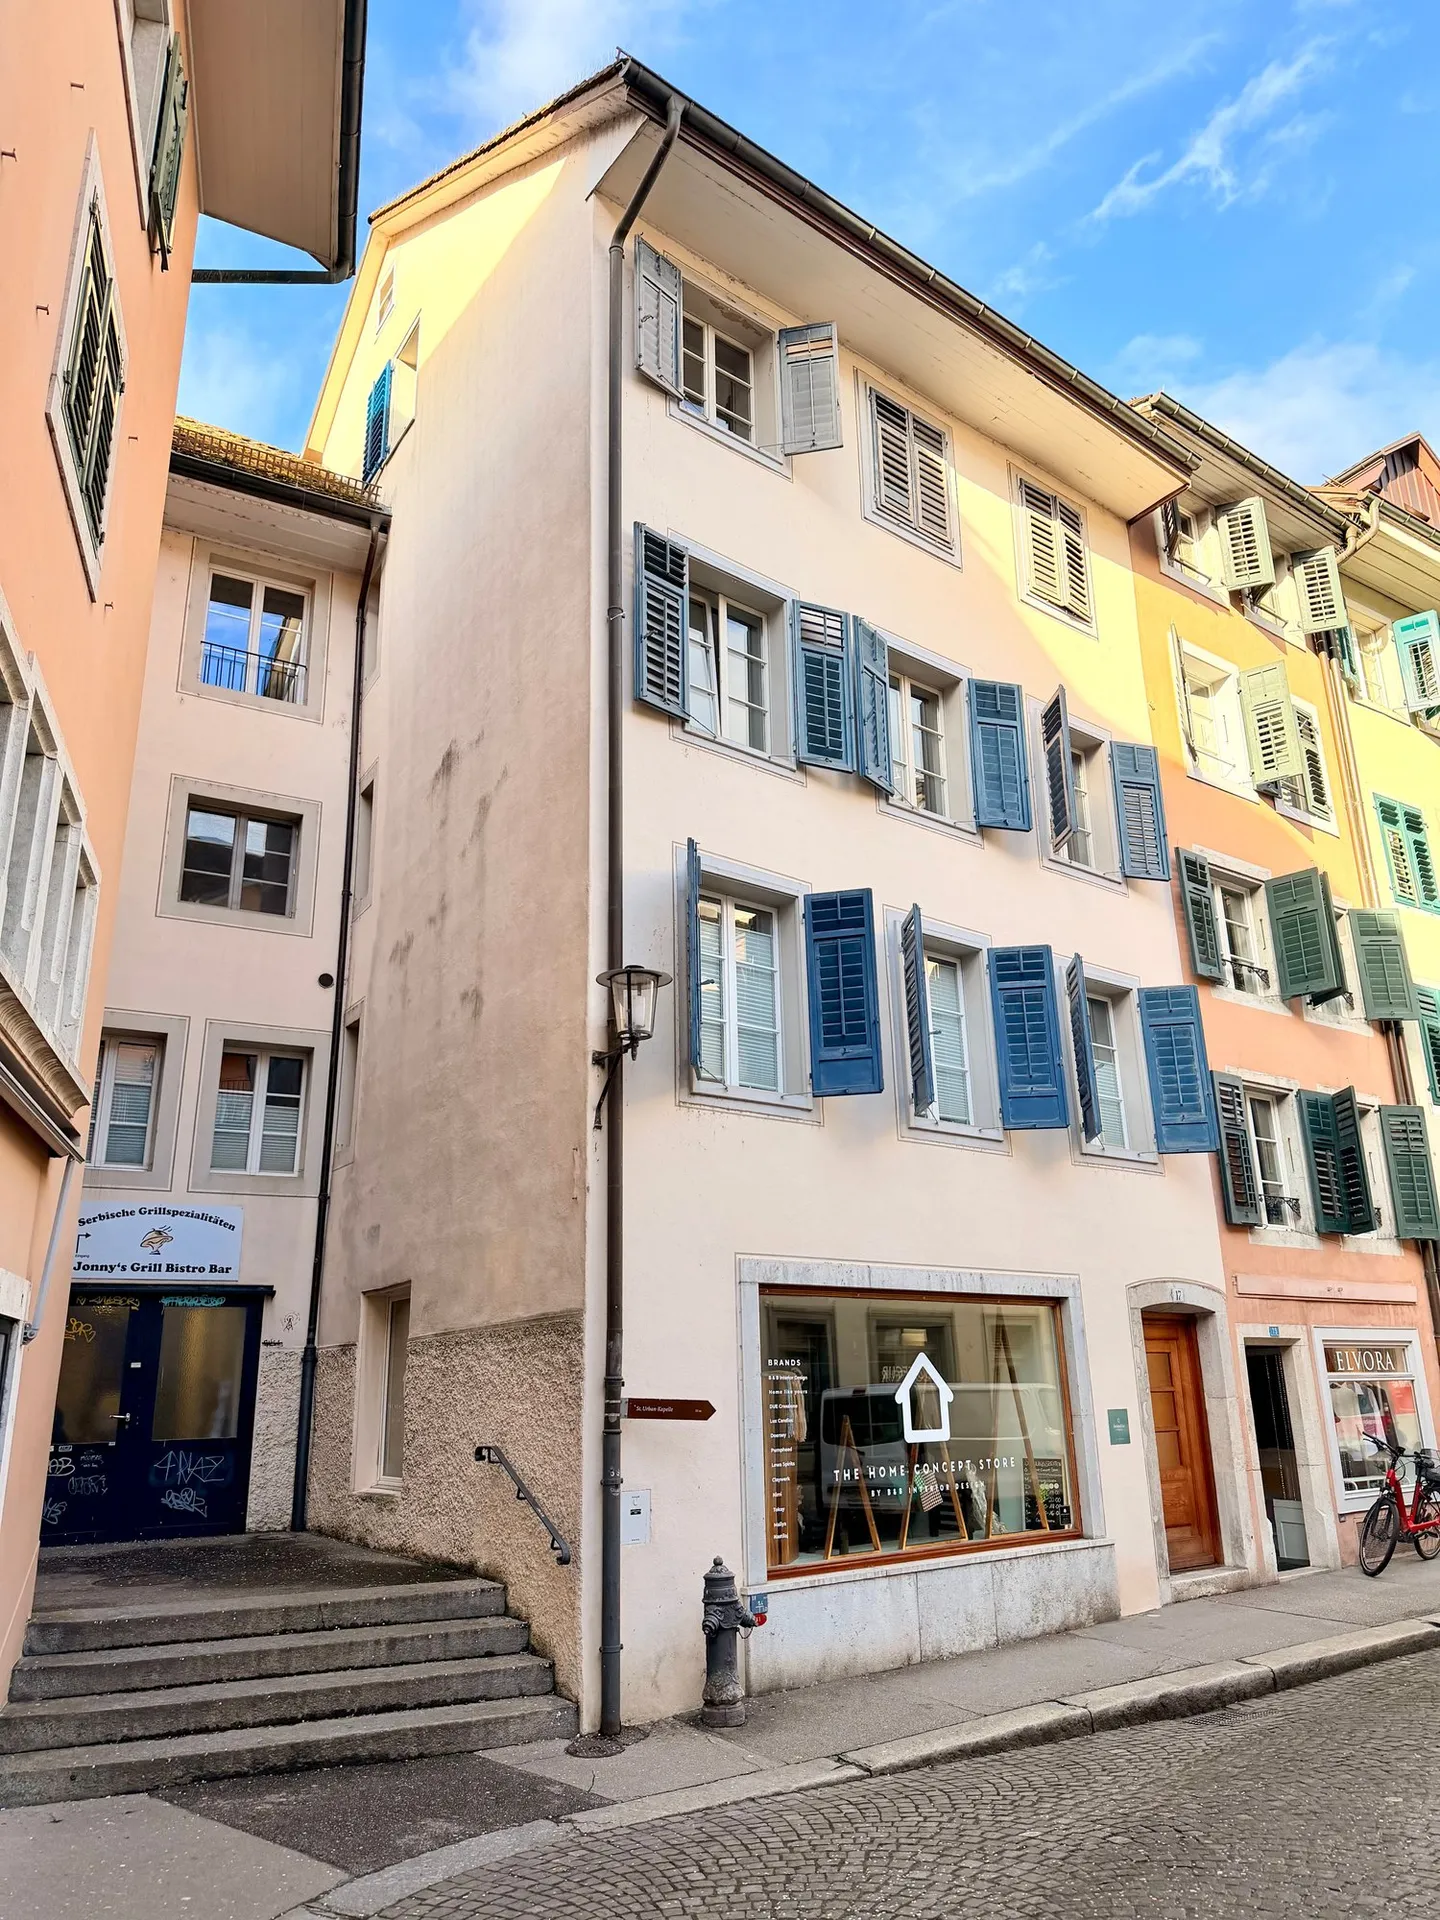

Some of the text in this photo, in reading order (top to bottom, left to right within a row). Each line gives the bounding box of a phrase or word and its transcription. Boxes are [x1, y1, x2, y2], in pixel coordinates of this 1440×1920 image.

[77, 1206, 236, 1232] Serbische Grillspezialitäten
[130, 1263, 162, 1273] Grill
[165, 1263, 205, 1274] Bistro
[208, 1264, 232, 1274] Bar
[1335, 1351, 1396, 1371] ELVORA
[833, 1457, 1016, 1482] THE HOME CONCEPT STORE
[871, 1489, 881, 1497] BY
[908, 1483, 950, 1494] INTERIOR
